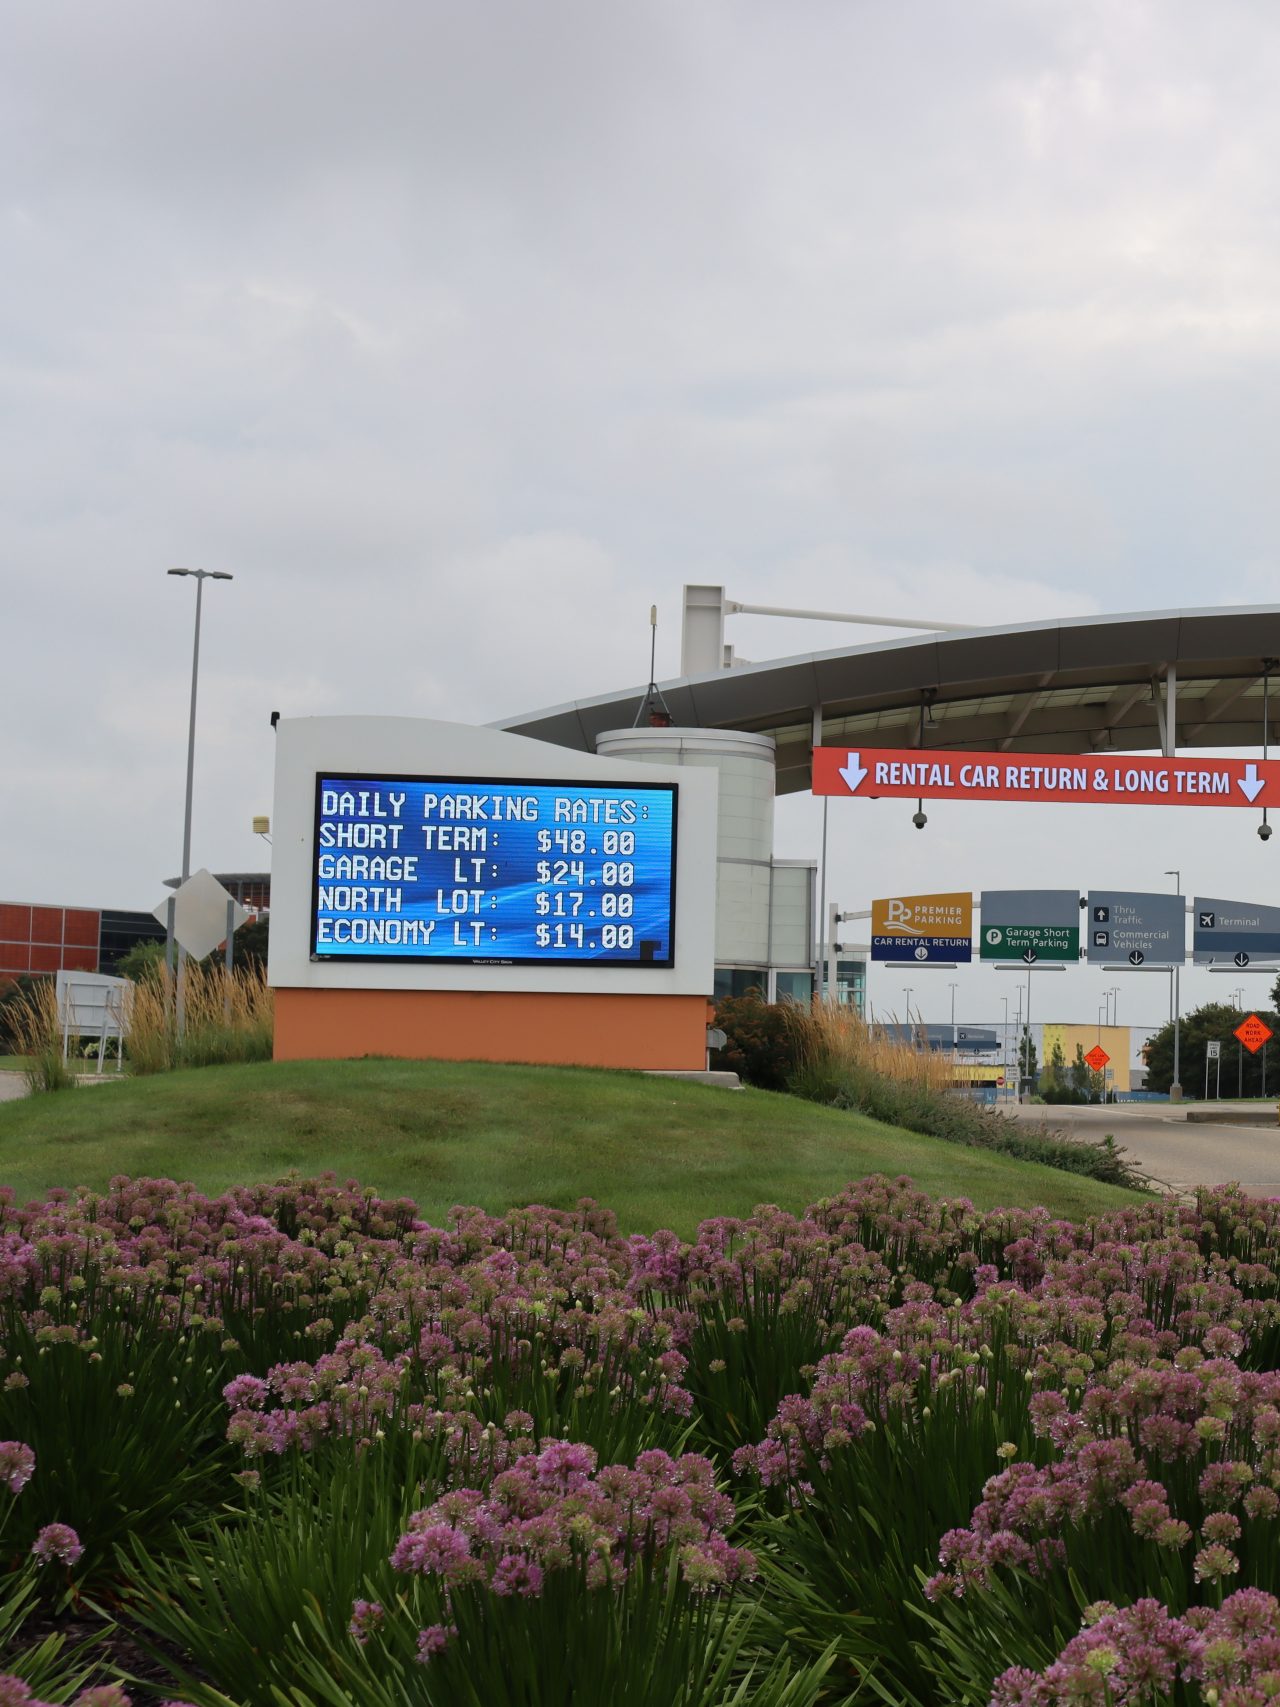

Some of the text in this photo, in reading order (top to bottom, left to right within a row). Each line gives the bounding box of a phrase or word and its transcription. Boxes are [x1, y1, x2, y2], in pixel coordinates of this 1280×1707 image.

[875, 762, 1230, 794] RENTAL CAR RETURN & LONG TERM
[322, 790, 648, 824] DAILY PARKING RATES:
[320, 822, 635, 855] SHORT TERM: $48.00
[318, 854, 634, 886] GARAGE LT: $24.00
[318, 886, 634, 918] NORTH LOT: $17.00
[915, 906, 962, 915] PREMIER
[1112, 906, 1136, 914] Thru
[915, 916, 962, 924] PARKING
[1113, 916, 1142, 924] Traffic
[1219, 917, 1260, 926] Terminal
[318, 918, 634, 949] ECONOMY LT: $14.00
[1006, 928, 1070, 938] Garage Short
[1113, 930, 1169, 939] Commercial
[874, 937, 969, 946] CAR RENTAL RETURN
[1006, 938, 1068, 949] Term Parking
[1113, 940, 1152, 949] Vehicles
